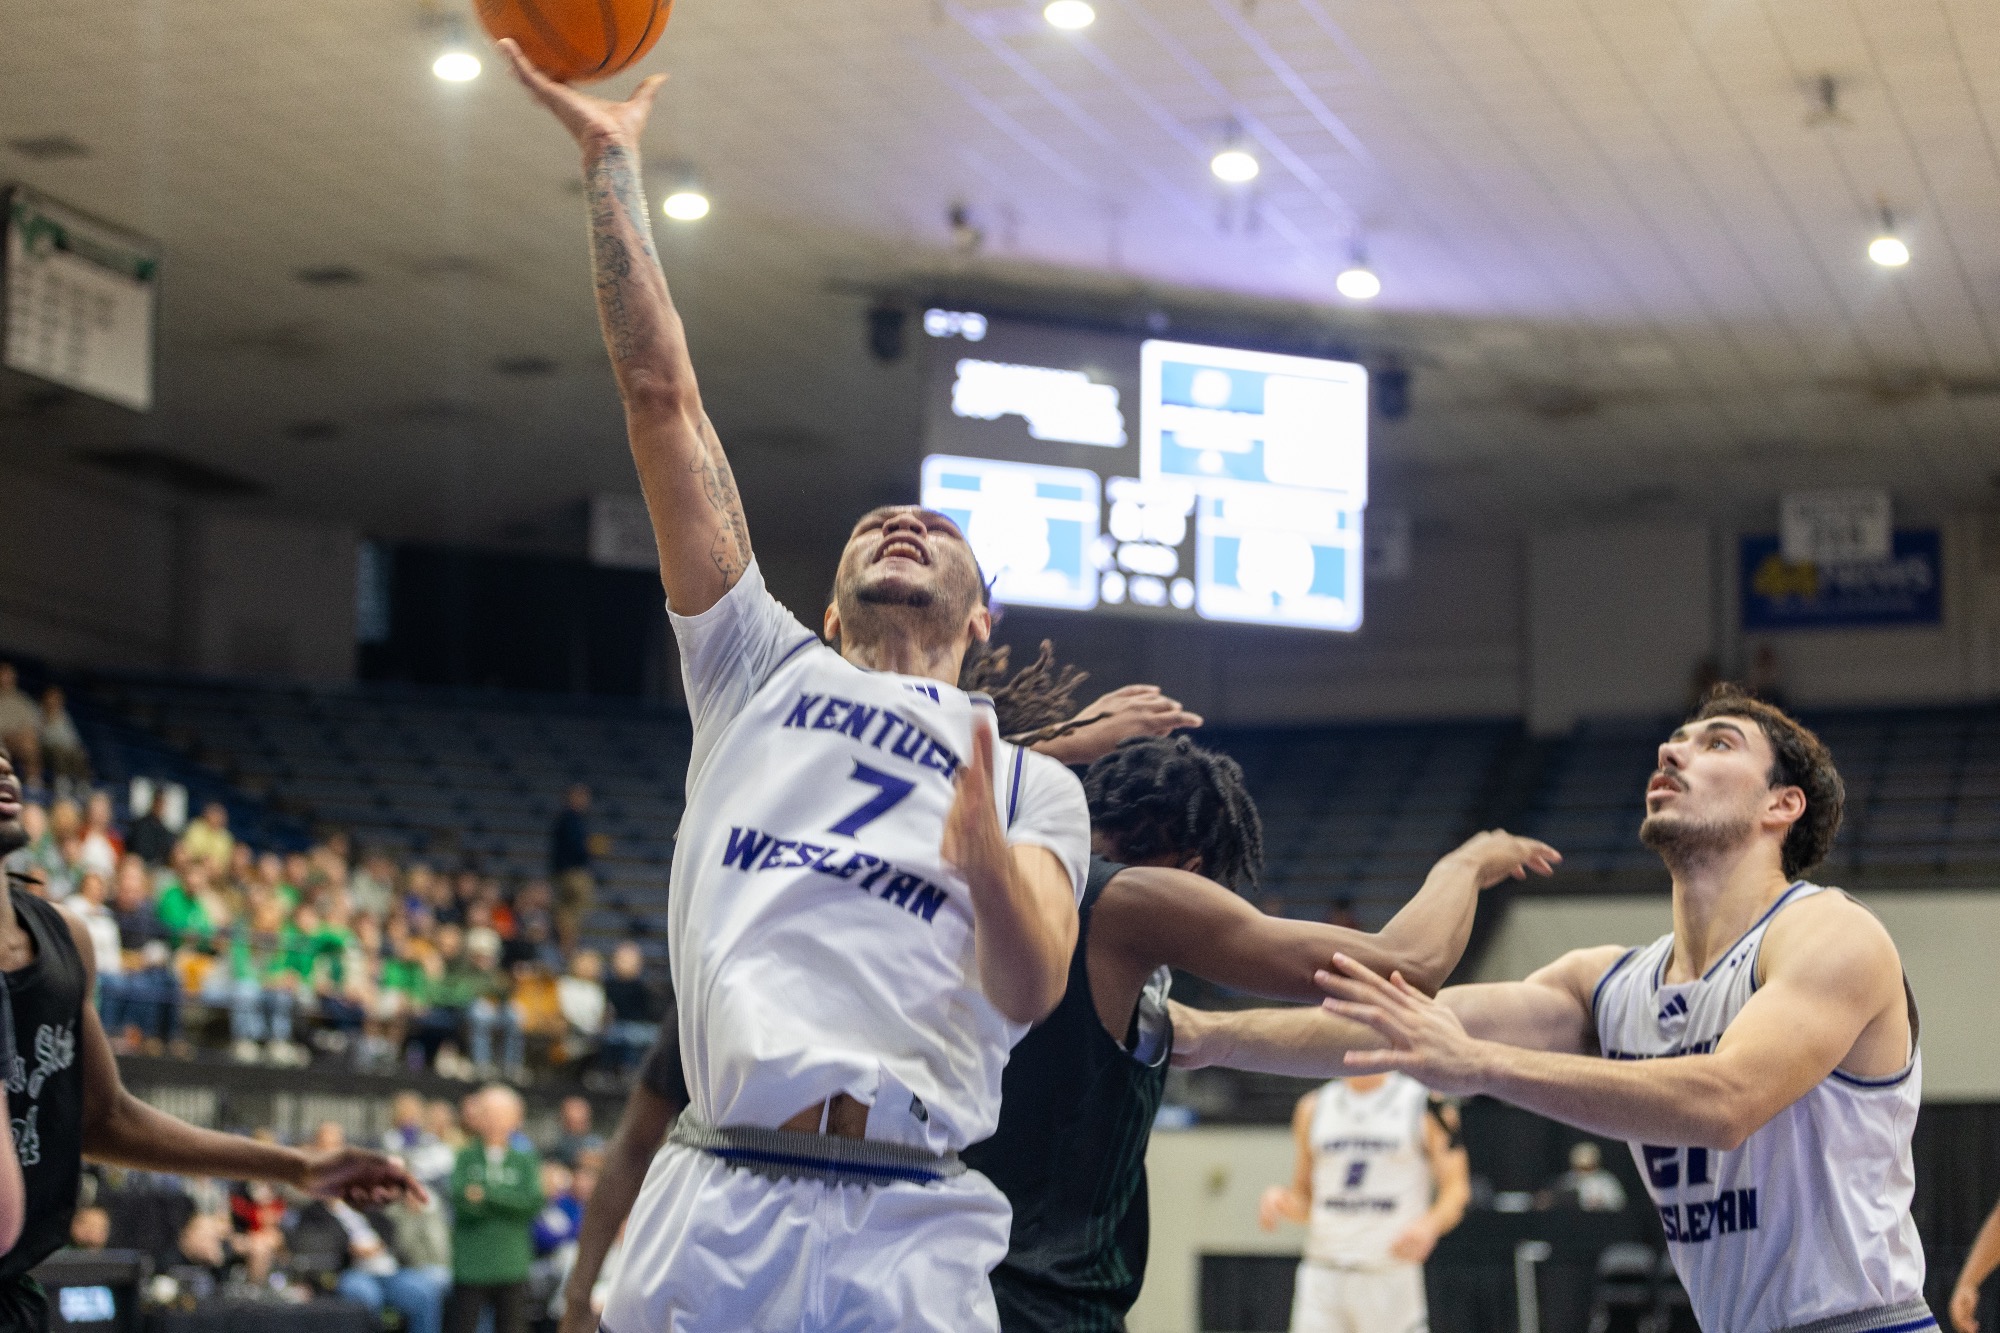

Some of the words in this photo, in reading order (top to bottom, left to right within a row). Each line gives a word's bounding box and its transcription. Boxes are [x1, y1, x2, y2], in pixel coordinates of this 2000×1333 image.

[827, 758, 917, 838] 7
[722, 827, 948, 923] WESLEYAN
[1660, 1187, 1758, 1243] SLEYAN
